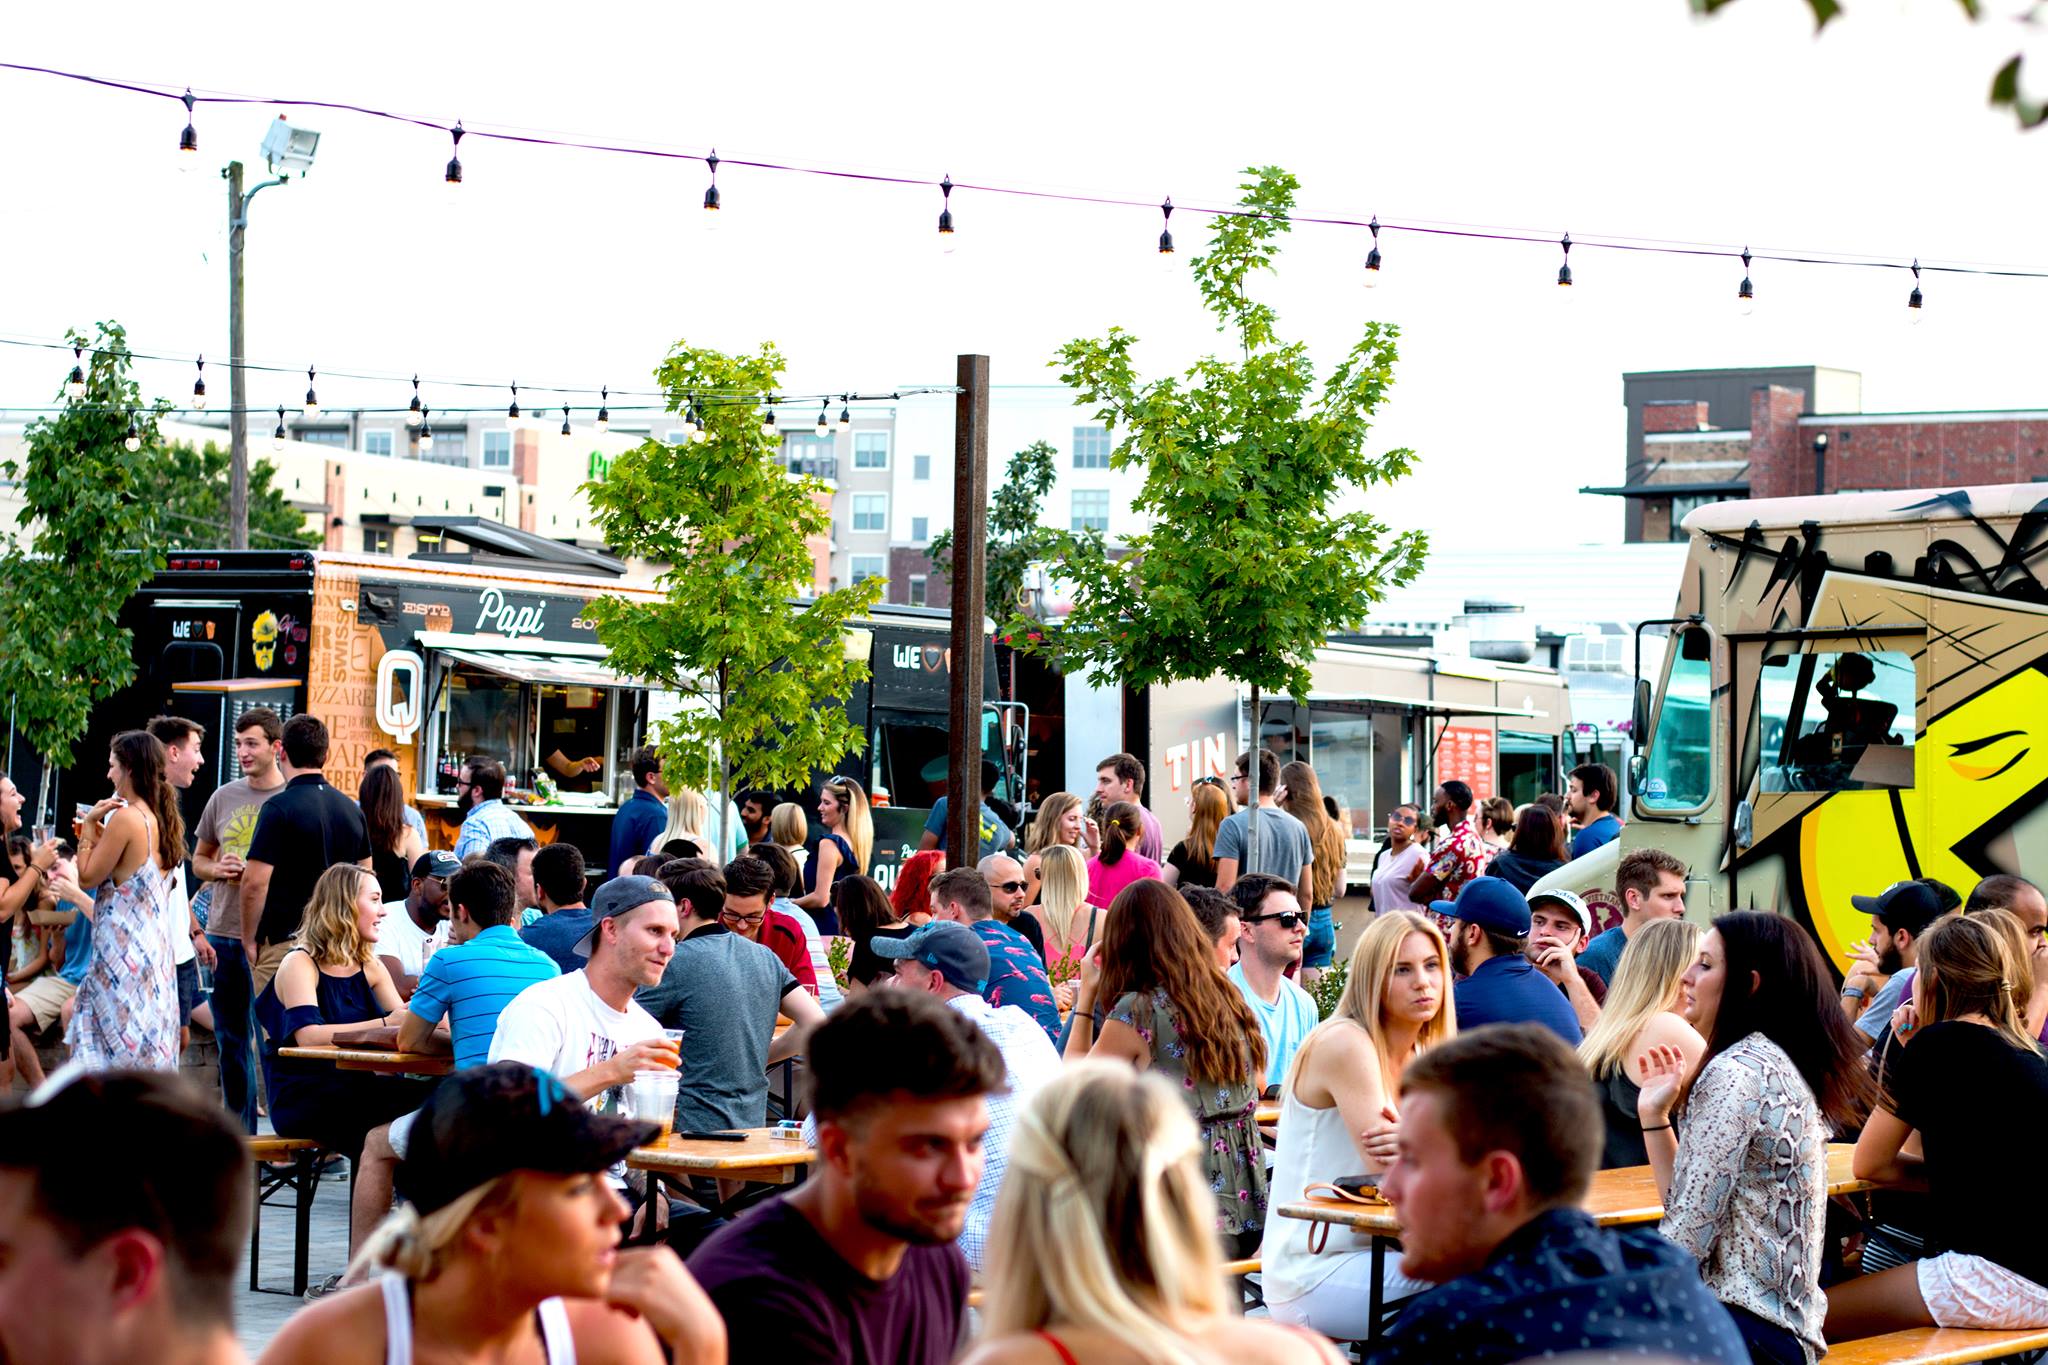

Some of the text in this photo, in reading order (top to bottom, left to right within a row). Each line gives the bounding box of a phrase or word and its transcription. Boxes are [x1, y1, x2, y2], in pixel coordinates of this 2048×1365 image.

[172, 620, 192, 638] WE
[475, 587, 547, 638] Papi
[571, 617, 600, 630] 20
[333, 611, 349, 683] SWISS
[893, 644, 922, 669] WE
[375, 649, 425, 745] Q
[1164, 732, 1226, 792] TIN
